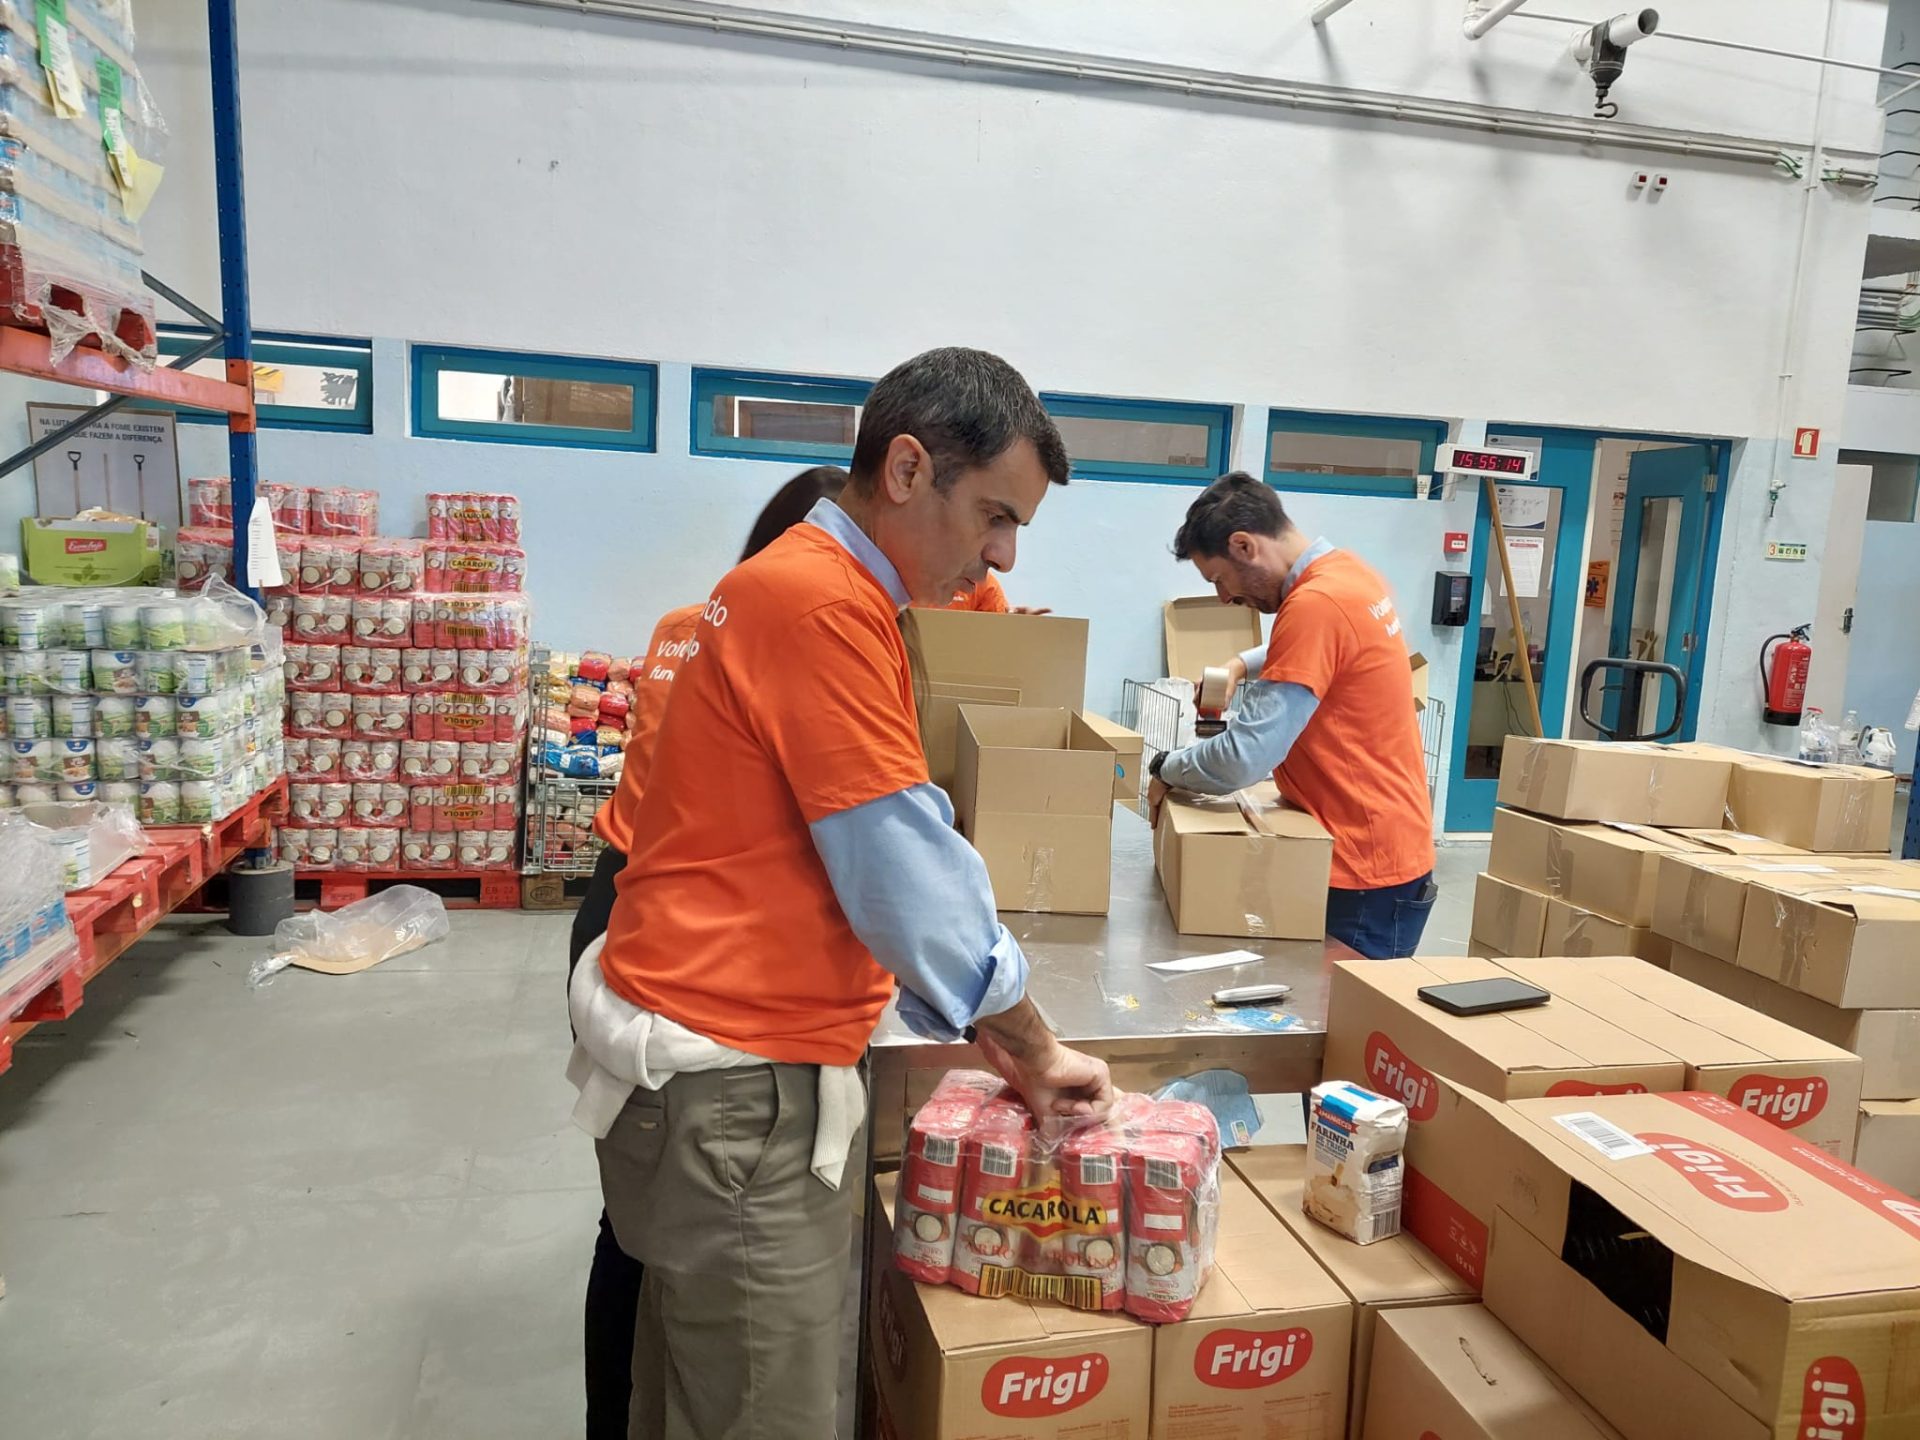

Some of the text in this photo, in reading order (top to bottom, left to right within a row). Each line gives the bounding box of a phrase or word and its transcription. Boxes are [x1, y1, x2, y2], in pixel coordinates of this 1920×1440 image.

[89, 432, 114, 440] FAZEM
[122, 434, 163, 444] DIFERENÇA
[111, 423, 132, 432] FOME
[133, 424, 165, 433] EXISTEM
[1372, 1047, 1429, 1109] Frigi
[1741, 1082, 1815, 1122] Frigi
[1310, 1121, 1356, 1152] FARINHA
[1648, 1143, 1772, 1199] Frigi
[1210, 1334, 1297, 1378] Frigi
[998, 1359, 1092, 1405] Frigi
[1806, 1379, 1856, 1440] igi
